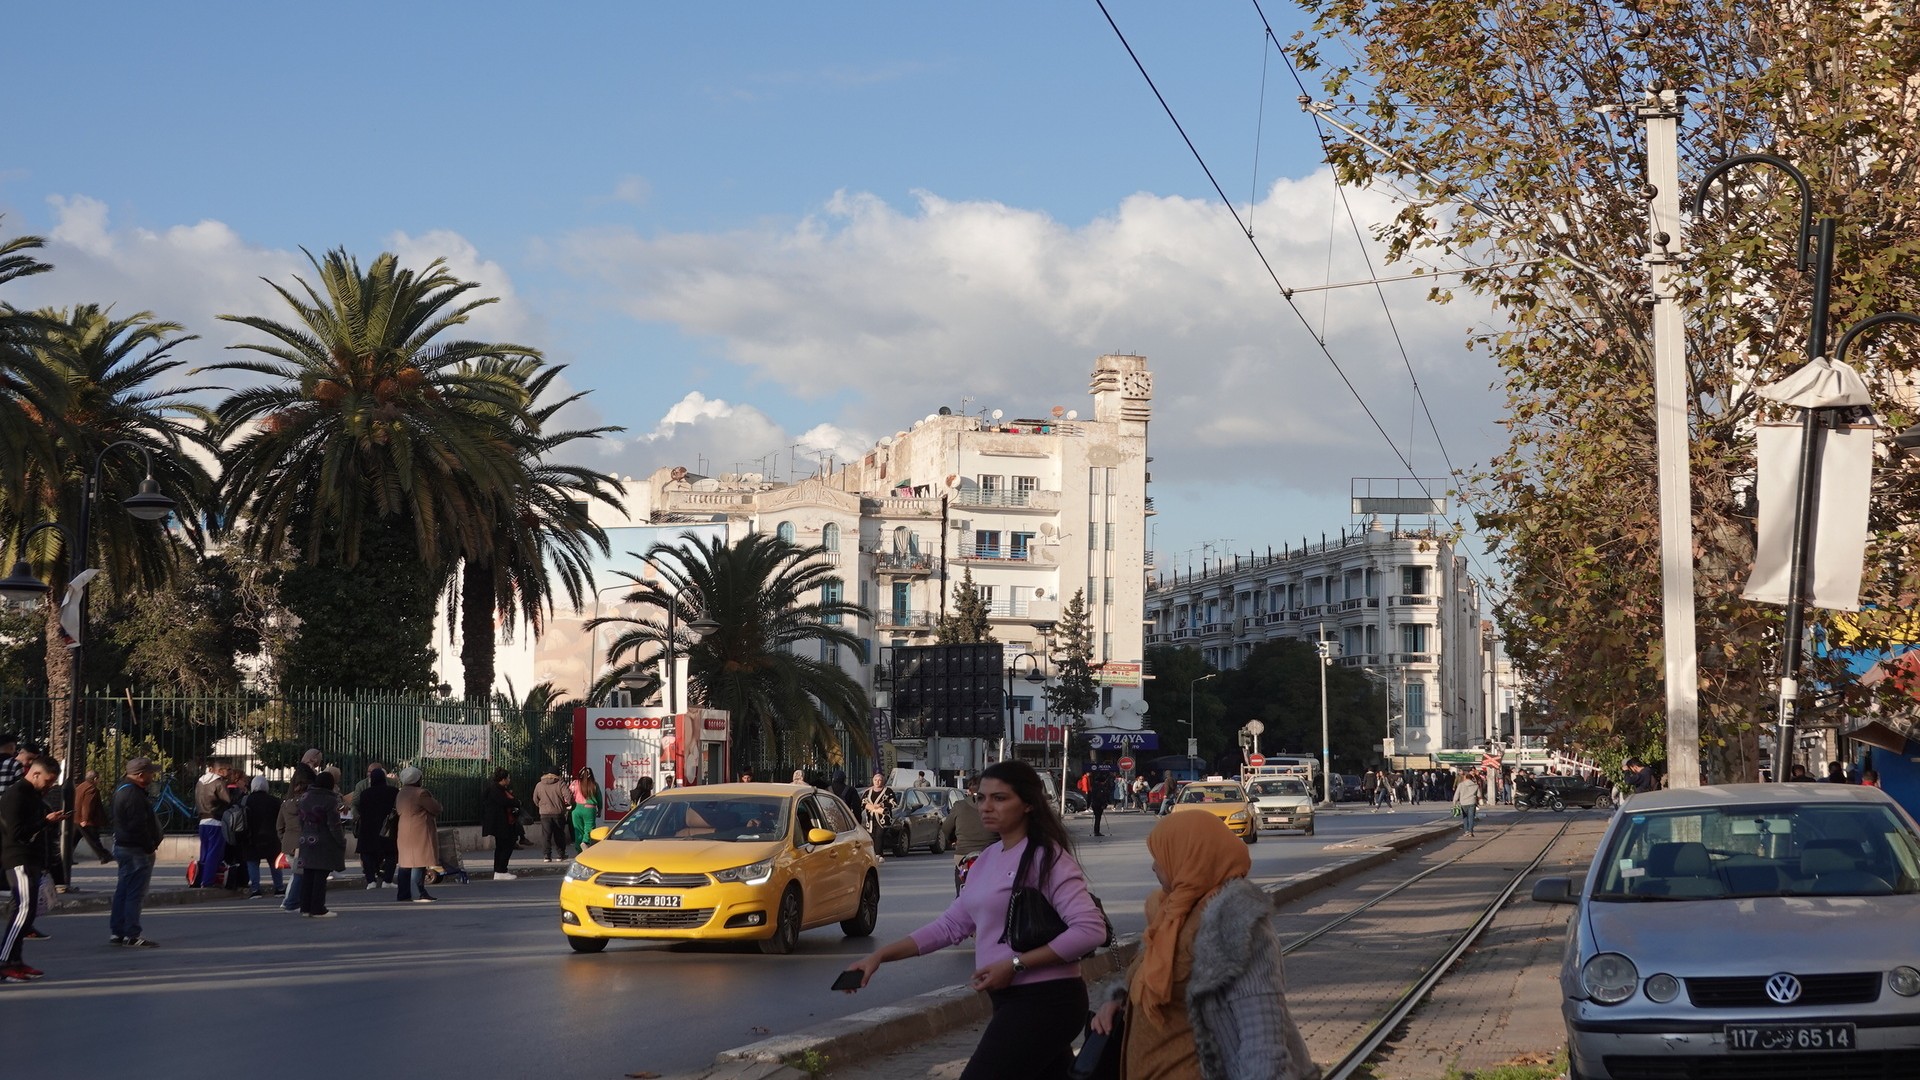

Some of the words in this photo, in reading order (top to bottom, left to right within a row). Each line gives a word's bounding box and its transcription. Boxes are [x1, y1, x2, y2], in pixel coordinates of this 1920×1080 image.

[597, 718, 660, 729] ooredoo
[1108, 734, 1145, 743] MAYA
[617, 895, 635, 906] 230
[638, 896, 652, 906] تونس
[654, 895, 678, 907] 8012
[1731, 1028, 1759, 1048] 117
[1761, 1029, 1794, 1049] تونس
[1797, 1028, 1849, 1048] 6514
